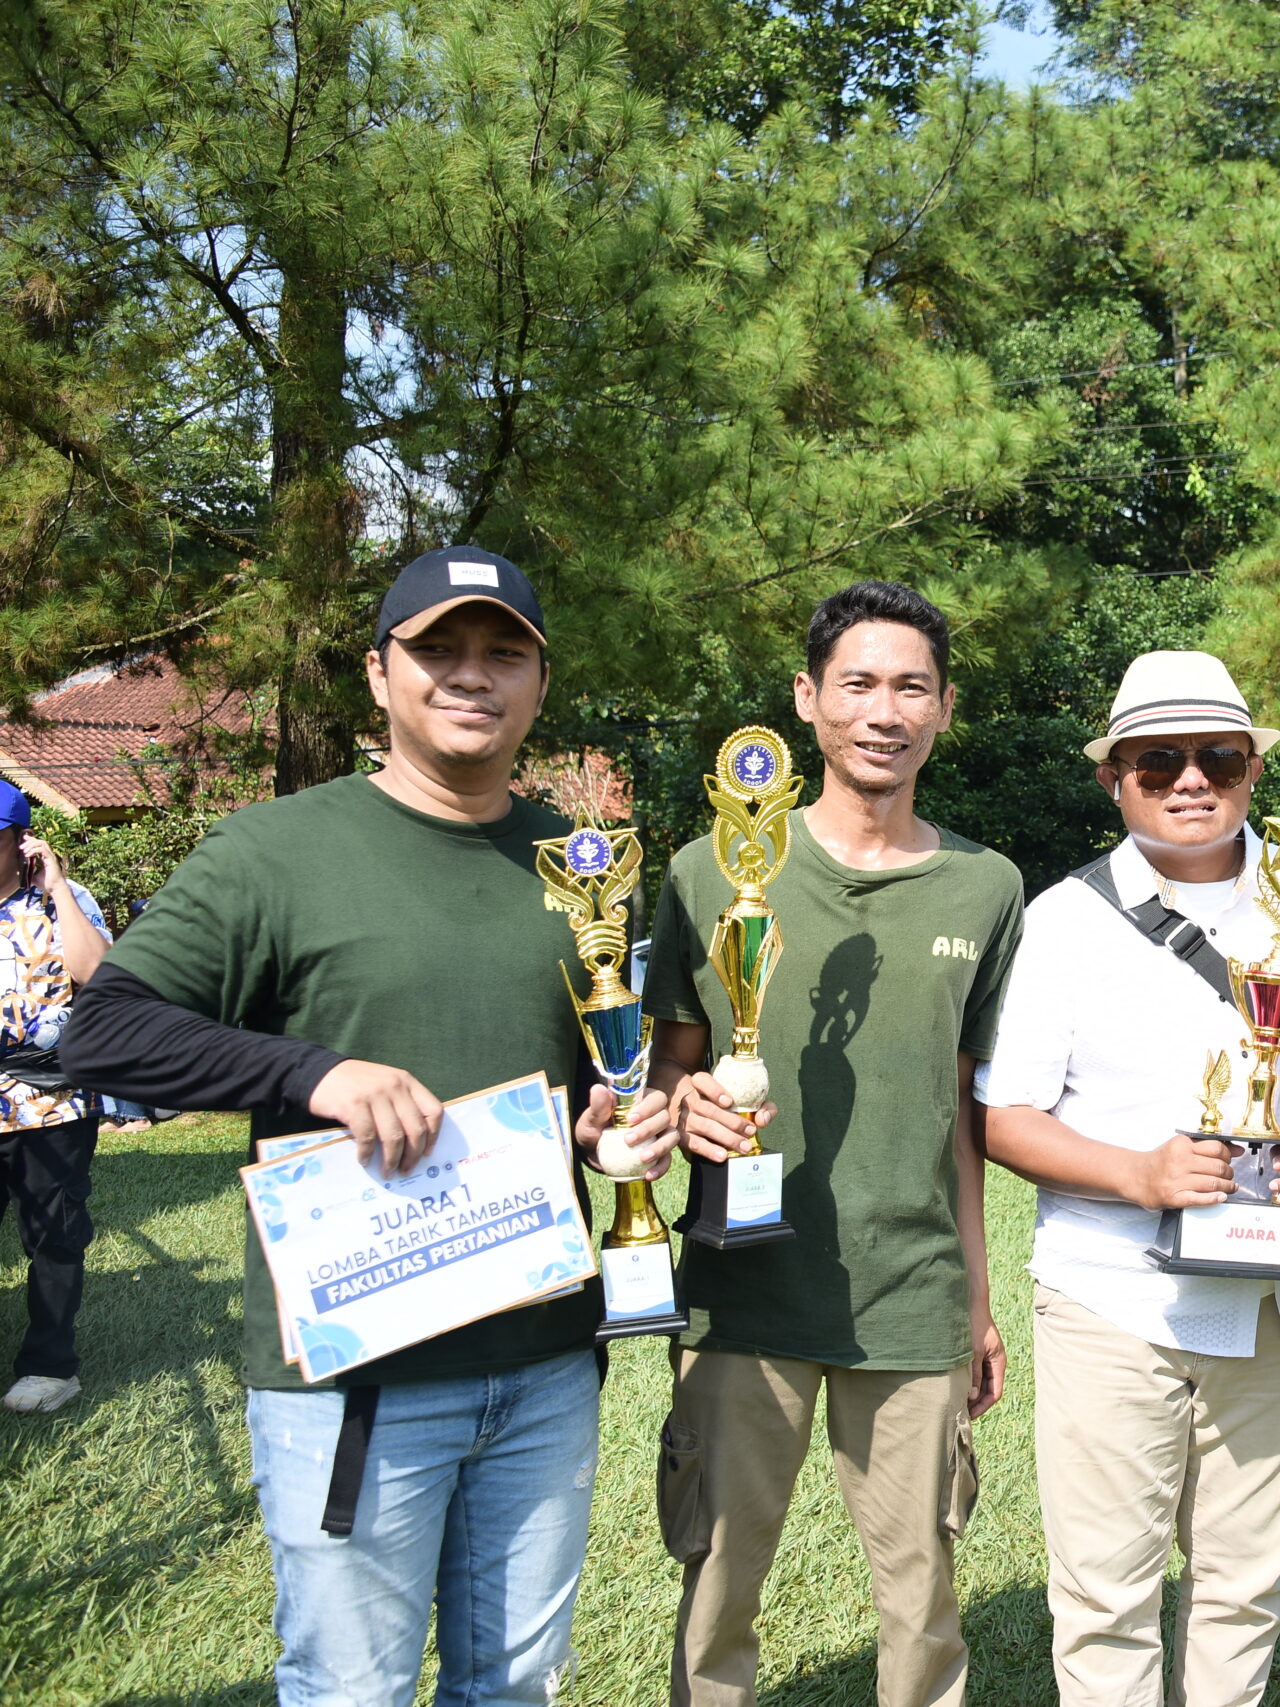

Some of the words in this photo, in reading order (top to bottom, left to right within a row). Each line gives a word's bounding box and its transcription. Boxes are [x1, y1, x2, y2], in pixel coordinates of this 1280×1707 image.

[307, 1247, 380, 1285] LOMBA
[384, 1222, 443, 1250] TARIK
[446, 1187, 546, 1232] TAMBANG
[370, 1191, 455, 1236] JUARA
[461, 1184, 472, 1202] 1
[1226, 1227, 1276, 1242] JUARA
[326, 1253, 428, 1304] FAKULTAS
[429, 1211, 541, 1265] PERTANIAN
